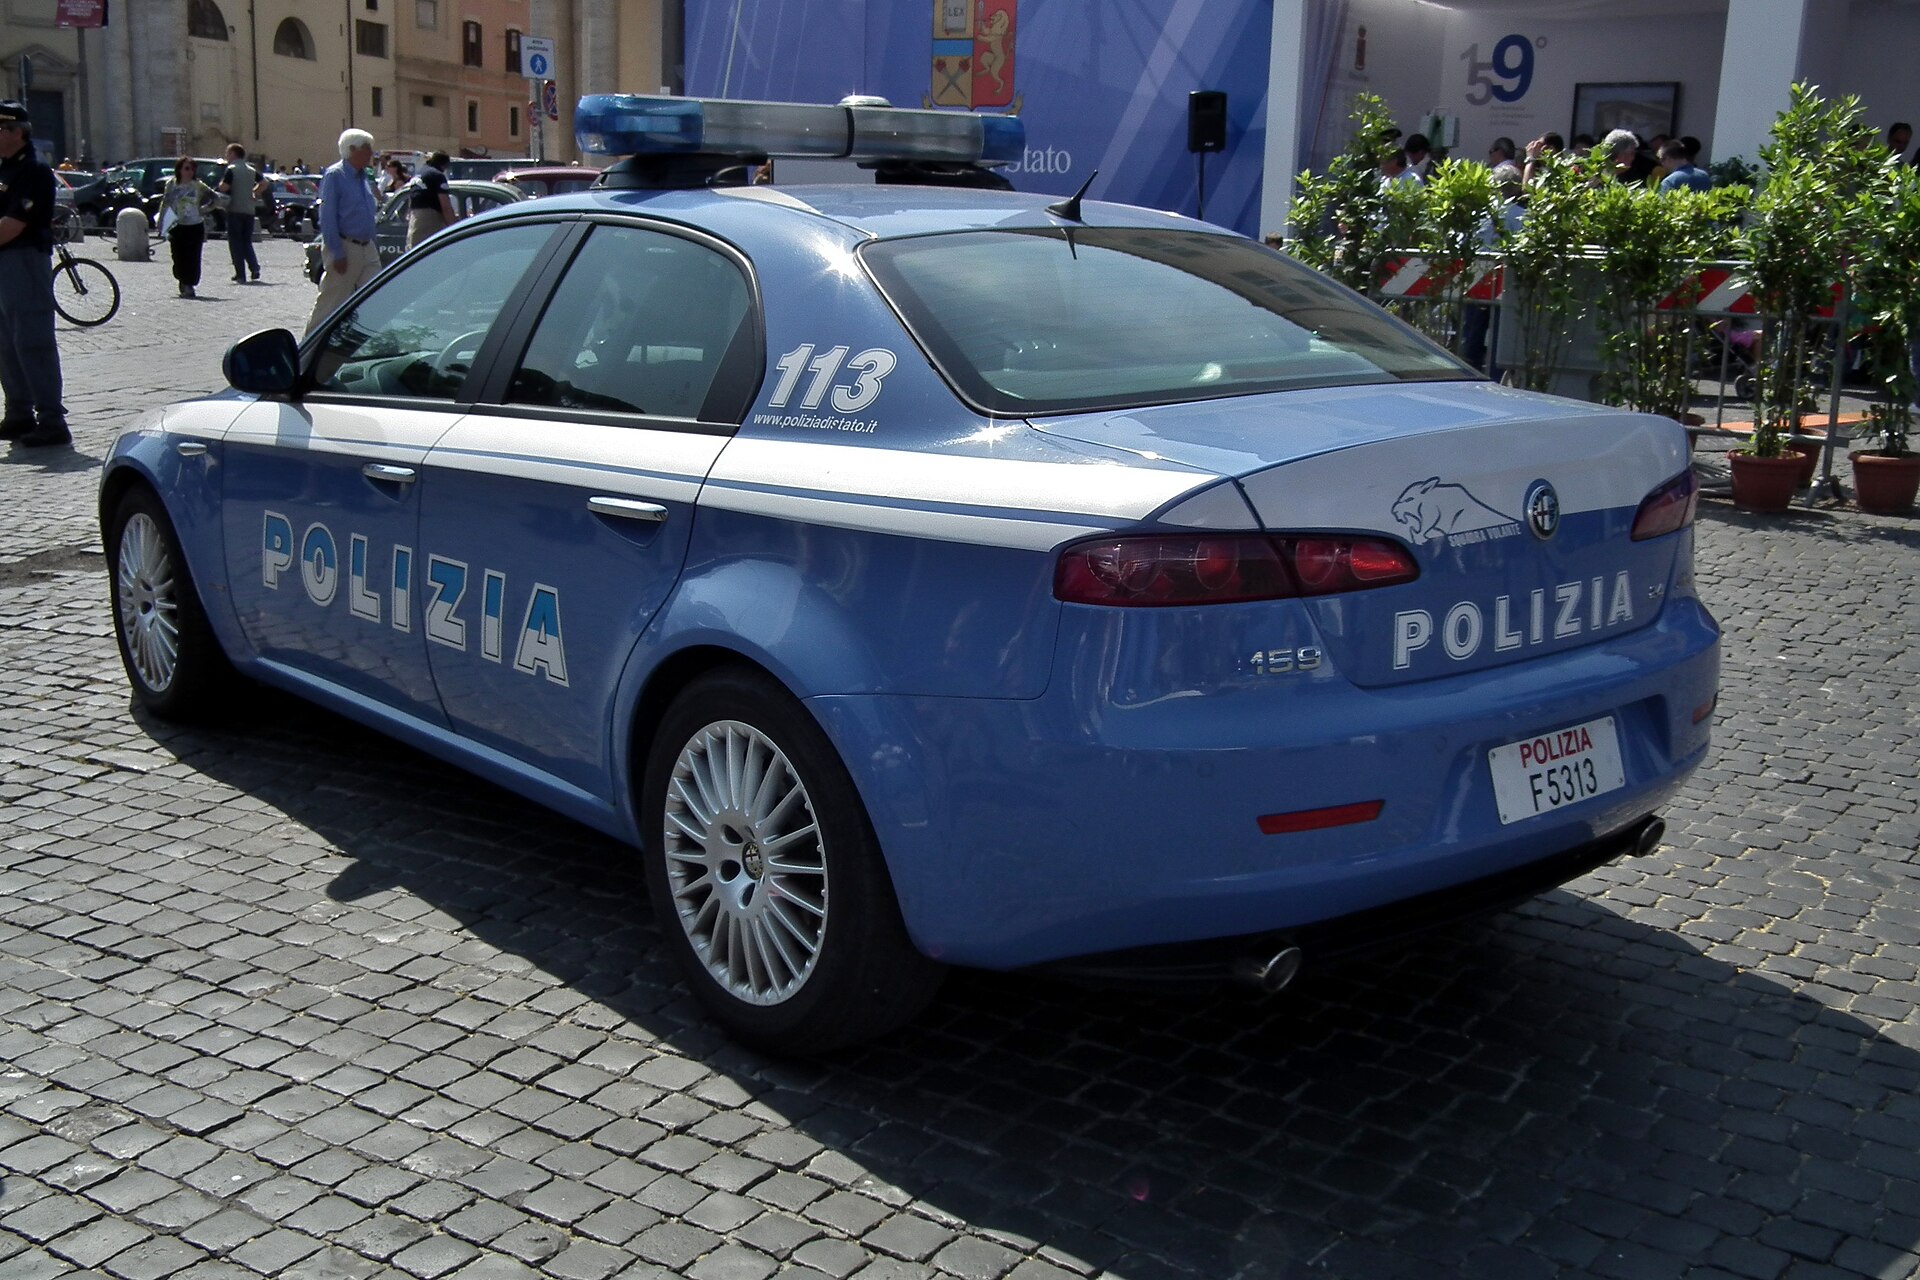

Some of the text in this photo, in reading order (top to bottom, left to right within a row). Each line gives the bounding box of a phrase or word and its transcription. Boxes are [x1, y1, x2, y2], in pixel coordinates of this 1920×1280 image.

[948, 7, 965, 17] LEX
[768, 343, 897, 414] 113
[262, 509, 570, 688] POLIZIA
[1393, 570, 1634, 670] POLIZIA
[1249, 646, 1322, 675] 159
[1519, 727, 1593, 768] POLIZIA
[1529, 757, 1598, 812] F5313
